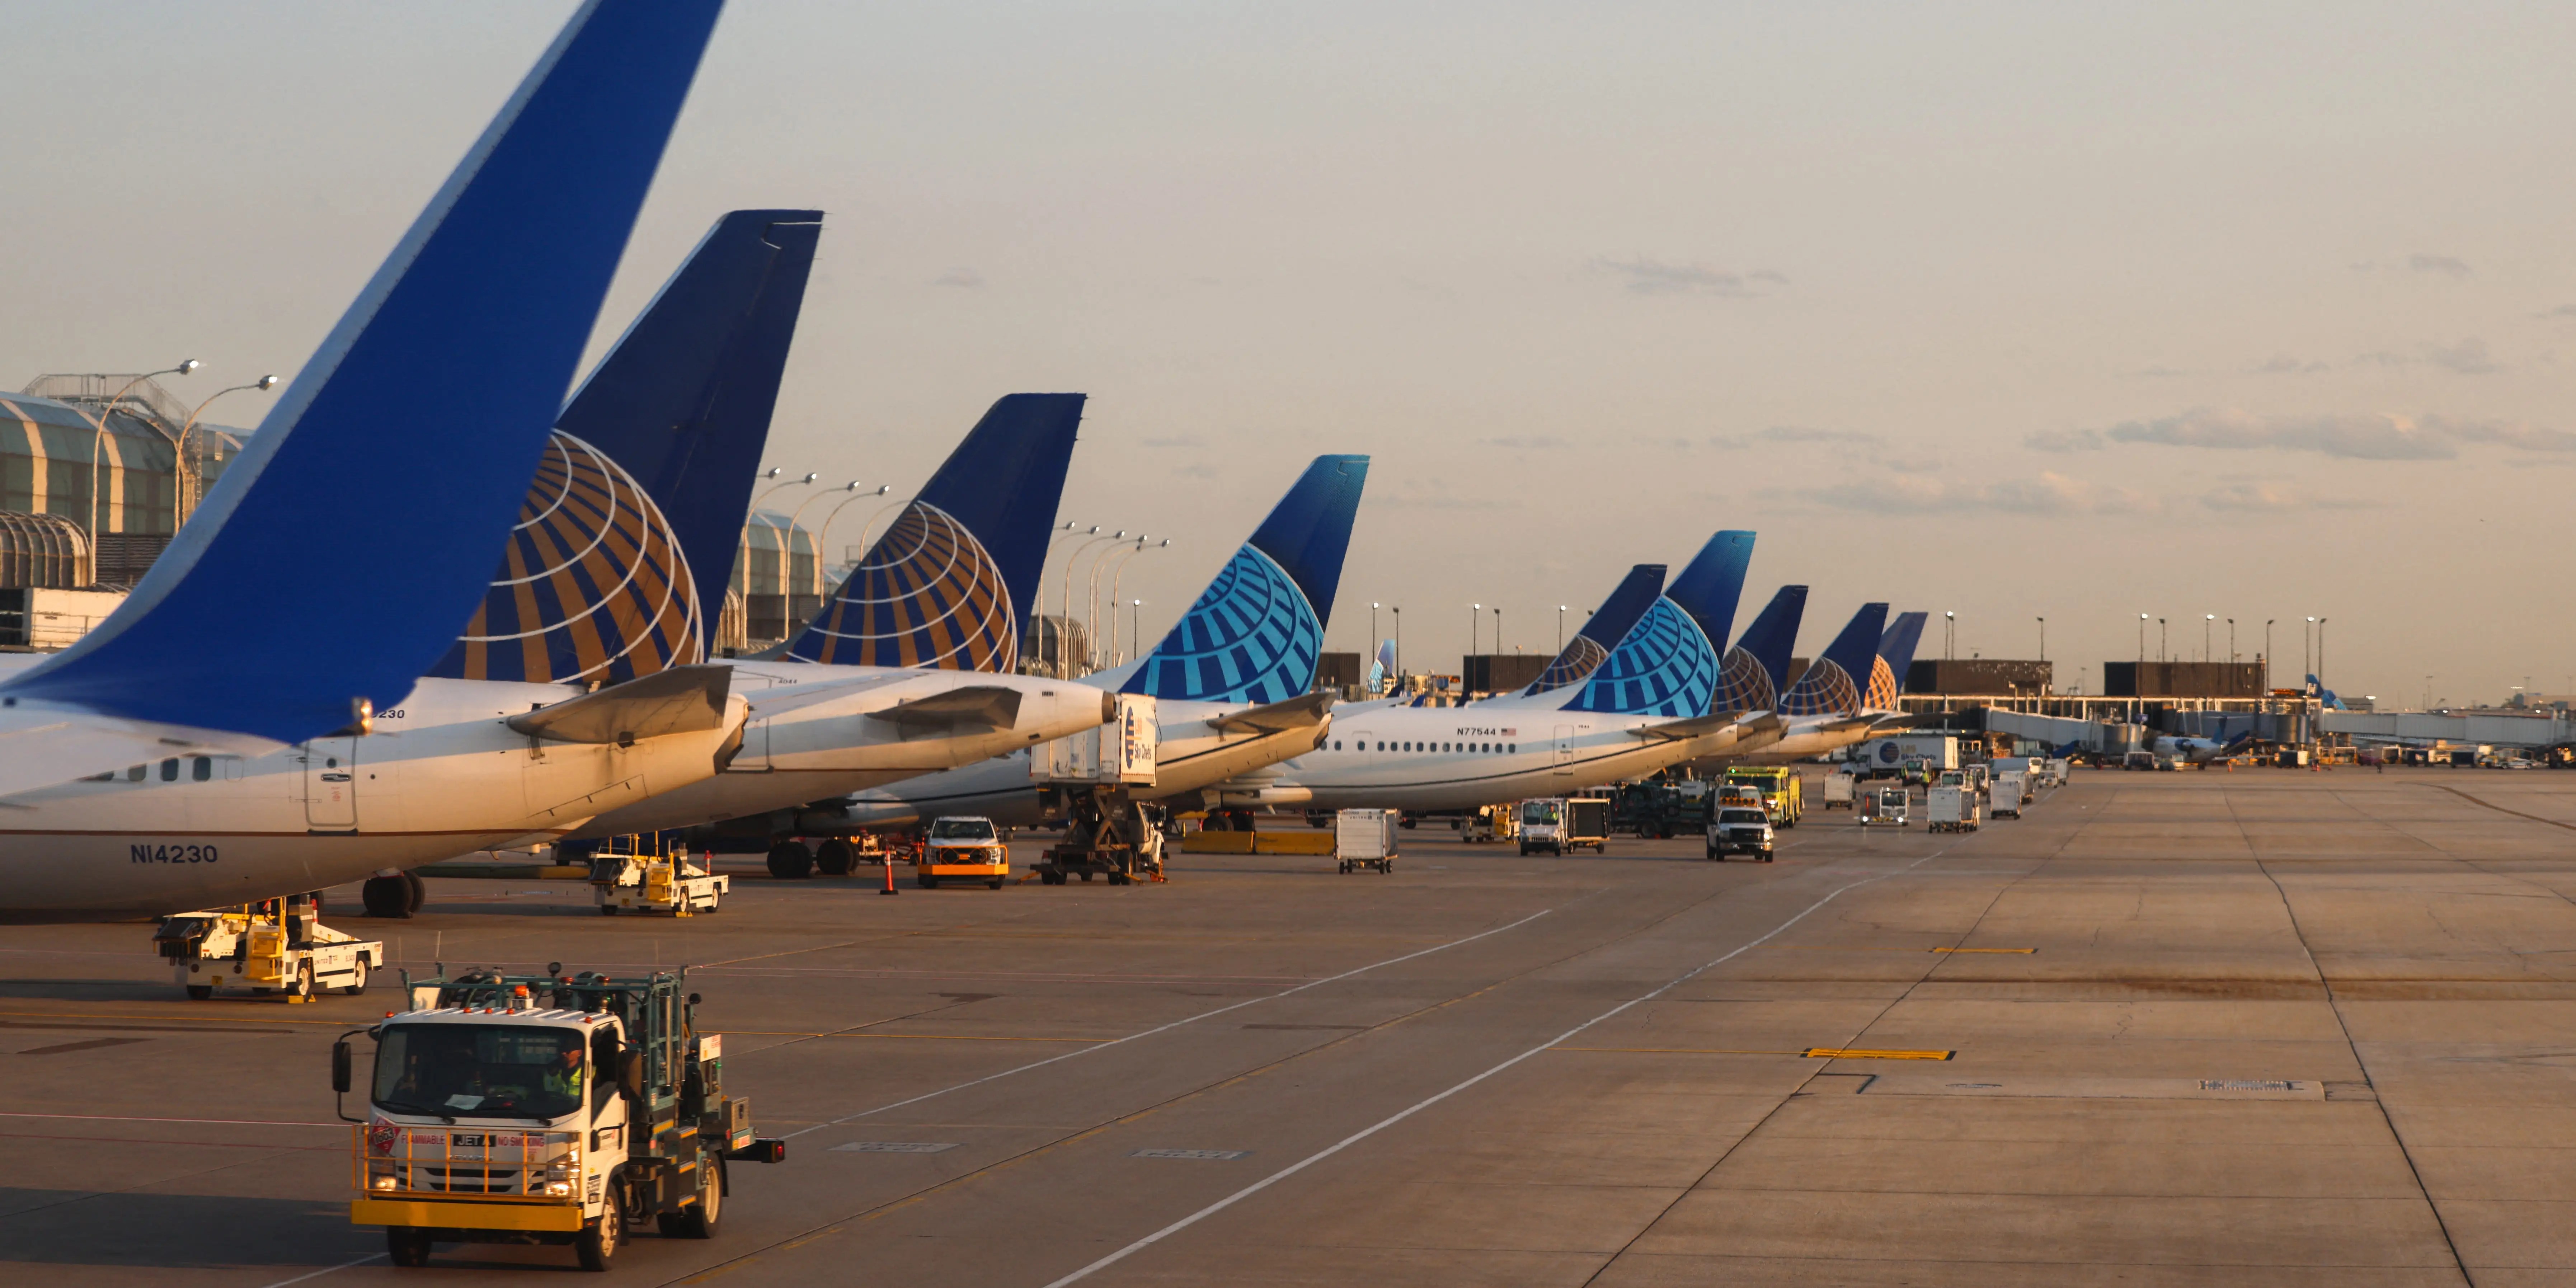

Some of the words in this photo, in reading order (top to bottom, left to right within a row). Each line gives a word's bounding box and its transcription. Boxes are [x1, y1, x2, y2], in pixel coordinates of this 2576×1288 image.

[373, 710, 405, 718] 230
[1142, 744, 1151, 760] Chefs
[131, 845, 217, 863] N14230
[458, 1136, 480, 1145] JET
[498, 1137, 509, 1146] NO
[511, 1137, 545, 1147] SMKING
